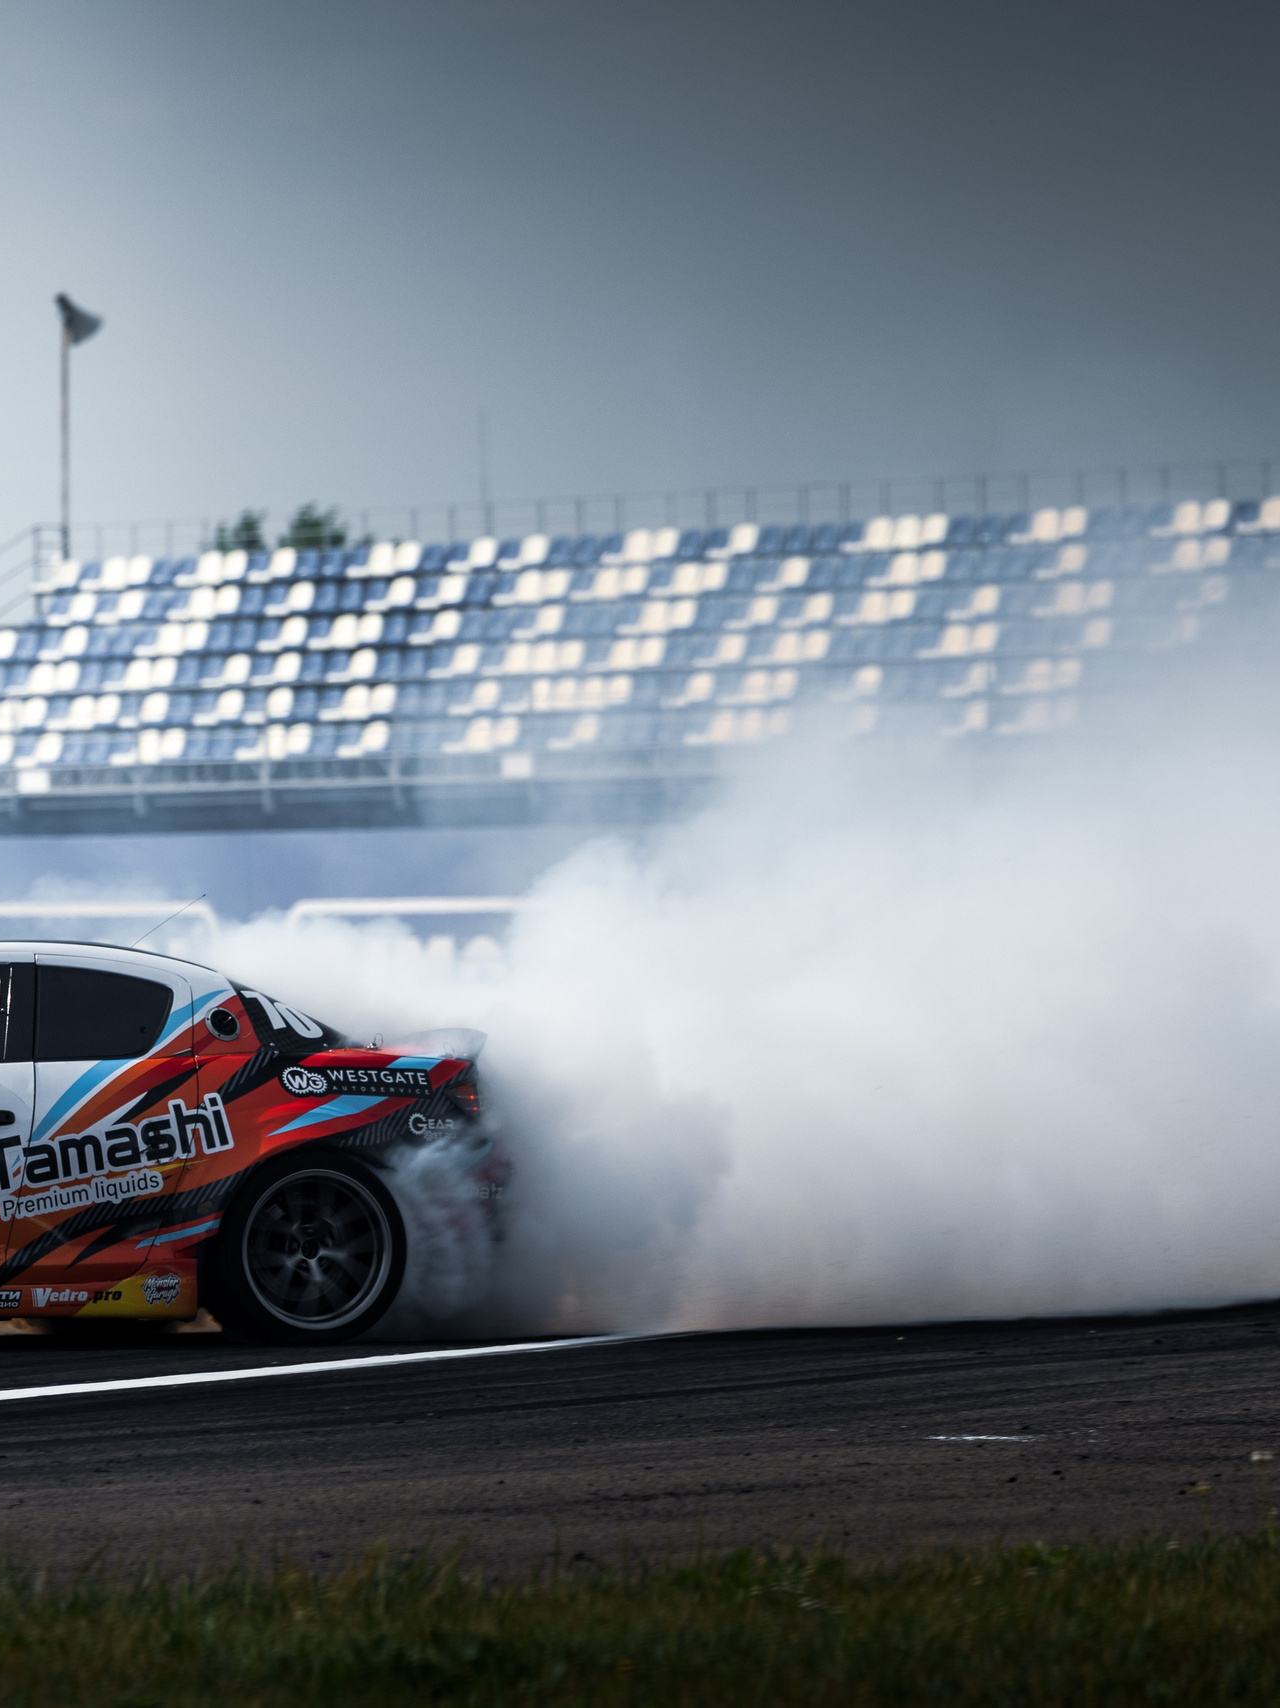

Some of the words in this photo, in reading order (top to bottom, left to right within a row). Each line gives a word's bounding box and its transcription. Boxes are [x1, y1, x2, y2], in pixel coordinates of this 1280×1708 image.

[327, 1069, 428, 1085] WESTGATE
[332, 1086, 430, 1095] AUTOSERVICE
[2, 1187, 89, 1217] Premium
[95, 1174, 160, 1200] liquids
[32, 1287, 88, 1308] Vedro
[92, 1289, 122, 1304] pro
